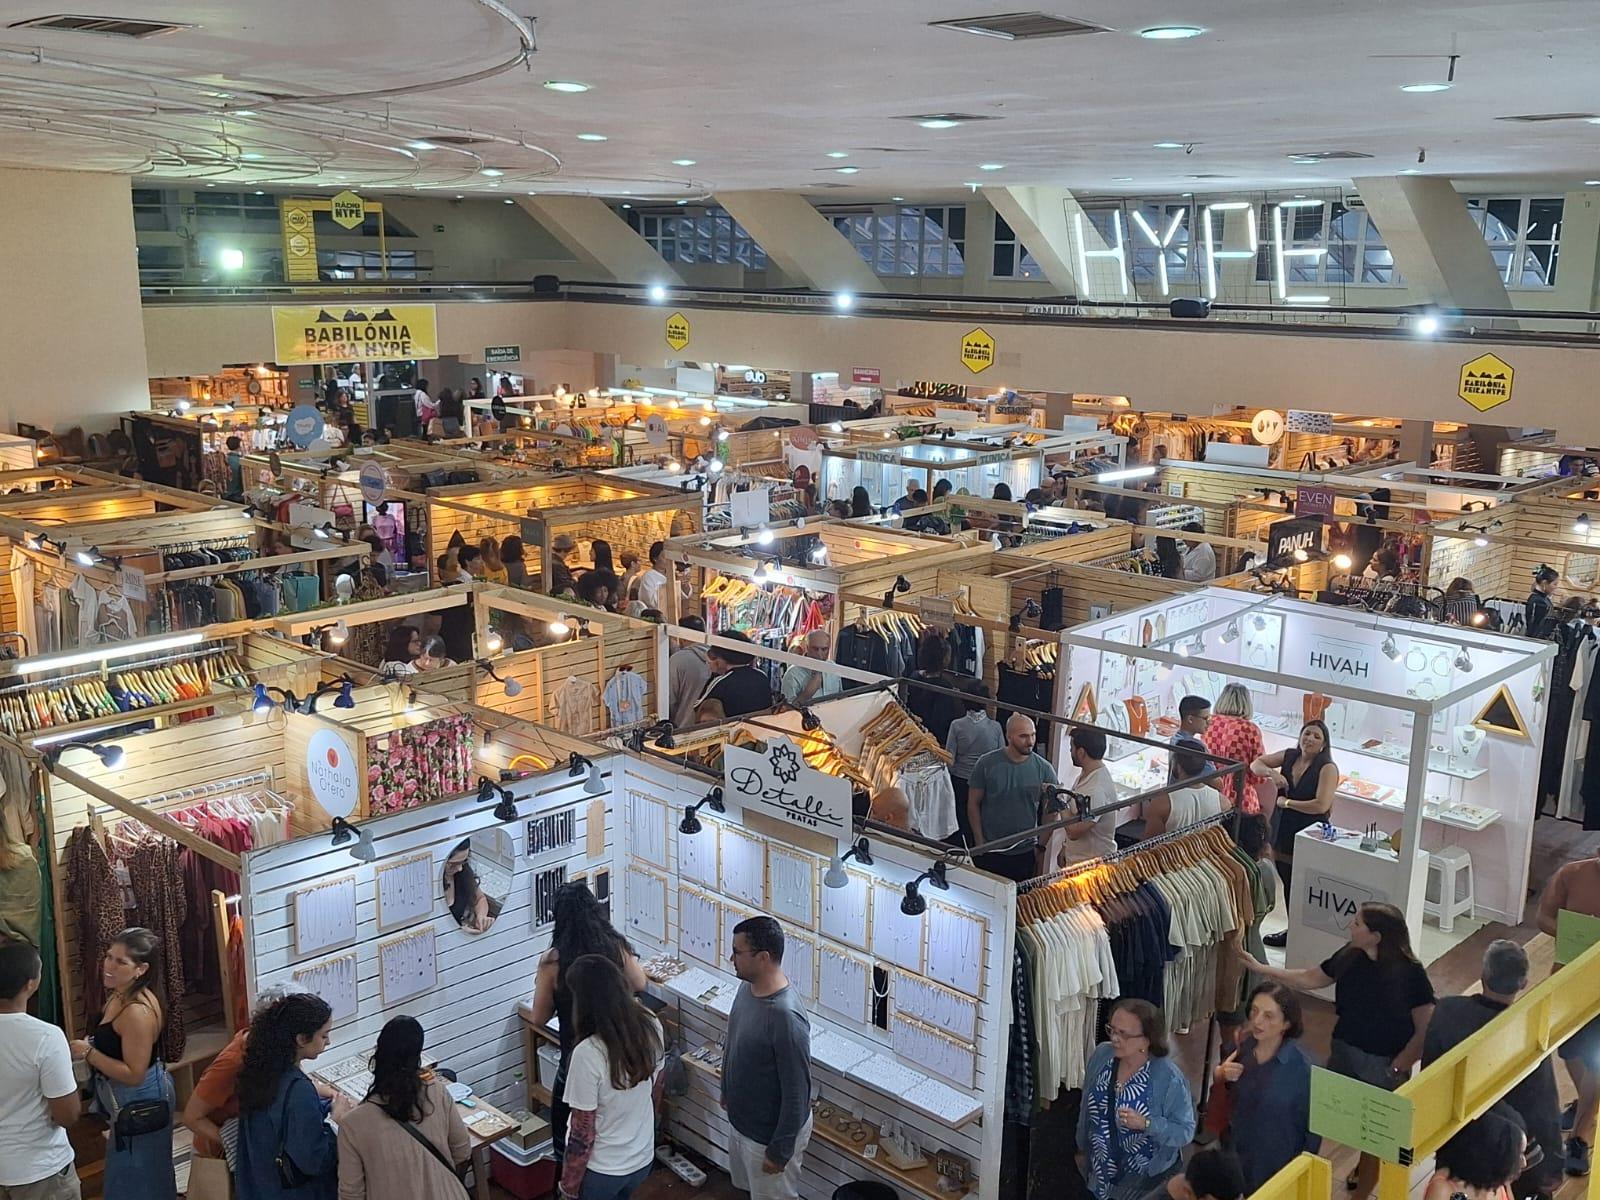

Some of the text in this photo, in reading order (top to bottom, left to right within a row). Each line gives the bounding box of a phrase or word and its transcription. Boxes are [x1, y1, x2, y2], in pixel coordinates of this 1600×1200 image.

[335, 209, 361, 218] HYPE
[1074, 199, 1331, 302] HYPE
[304, 322, 412, 344] BABILÔNIA
[305, 339, 412, 359] FEIRA HYPE
[1299, 490, 1333, 506] EVEN
[1309, 650, 1369, 679] HIVAH
[730, 766, 844, 821] Detalli
[785, 811, 818, 827] PRATAS
[1308, 886, 1359, 917] HIVA
